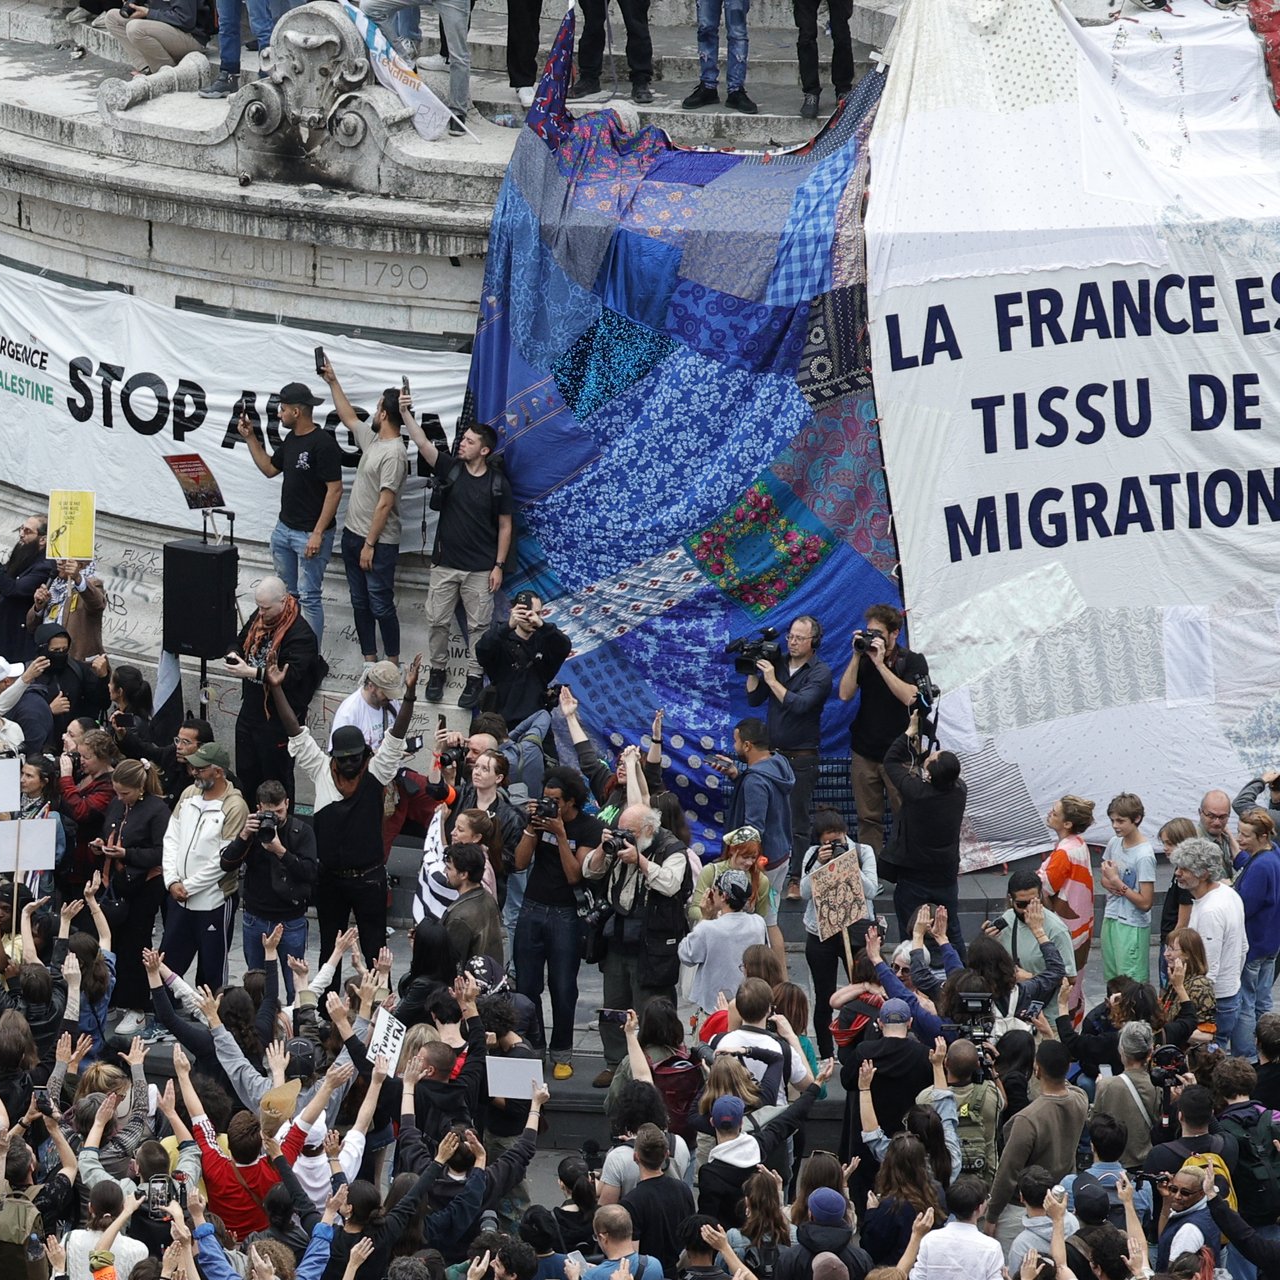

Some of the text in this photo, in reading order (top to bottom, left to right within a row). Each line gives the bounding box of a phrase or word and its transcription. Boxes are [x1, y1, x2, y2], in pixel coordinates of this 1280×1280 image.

[46, 206, 85, 237] 1789
[209, 240, 232, 267] 14
[243, 247, 352, 283] JUILLET
[363, 259, 429, 290] 1790
[886, 304, 963, 372] LA
[994, 273, 1218, 352] FRANCE
[67, 356, 208, 442] STOP
[971, 373, 1261, 454] TISSU DE
[122, 549, 159, 566] FUCK
[393, 1021, 405, 1041] FN
